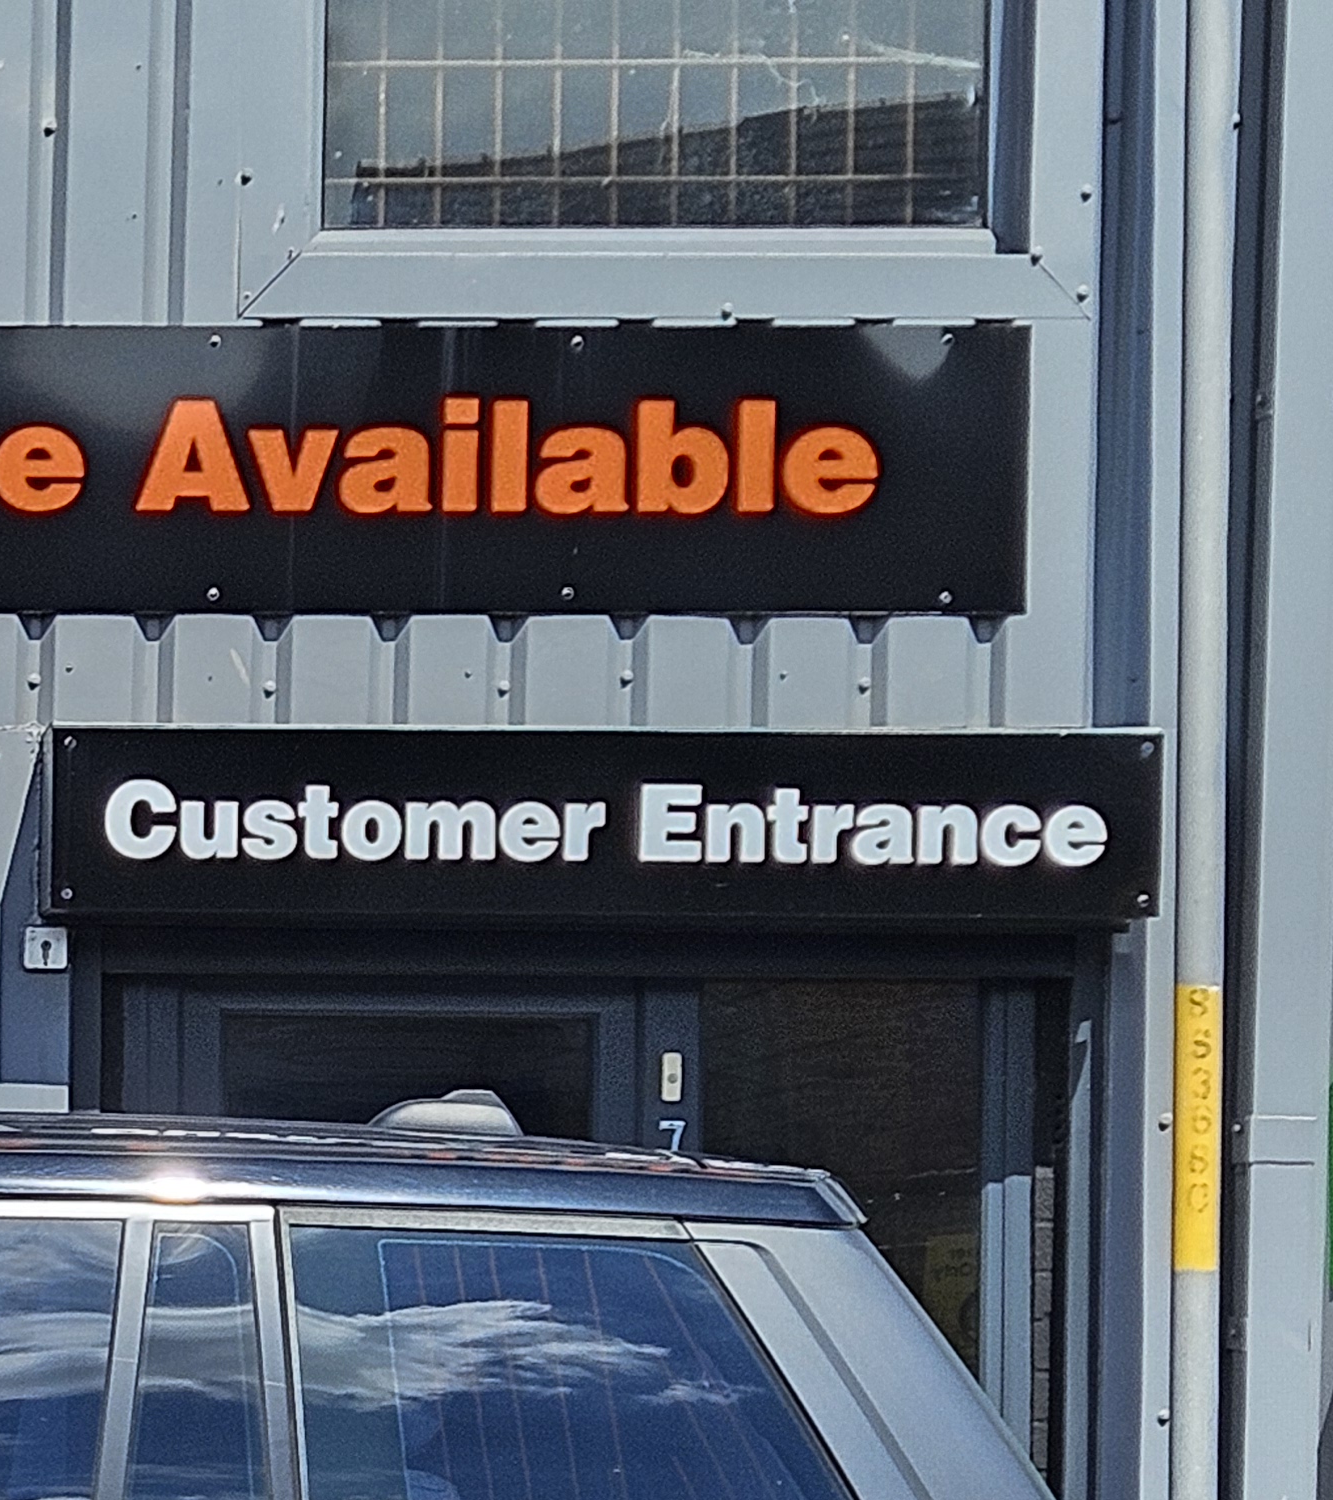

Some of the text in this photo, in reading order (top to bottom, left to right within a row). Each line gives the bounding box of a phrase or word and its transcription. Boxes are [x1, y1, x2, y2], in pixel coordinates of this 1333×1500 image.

[134, 397, 880, 514] Available
[104, 779, 1108, 867] Customer Entrance
[659, 1120, 686, 1151] 7
